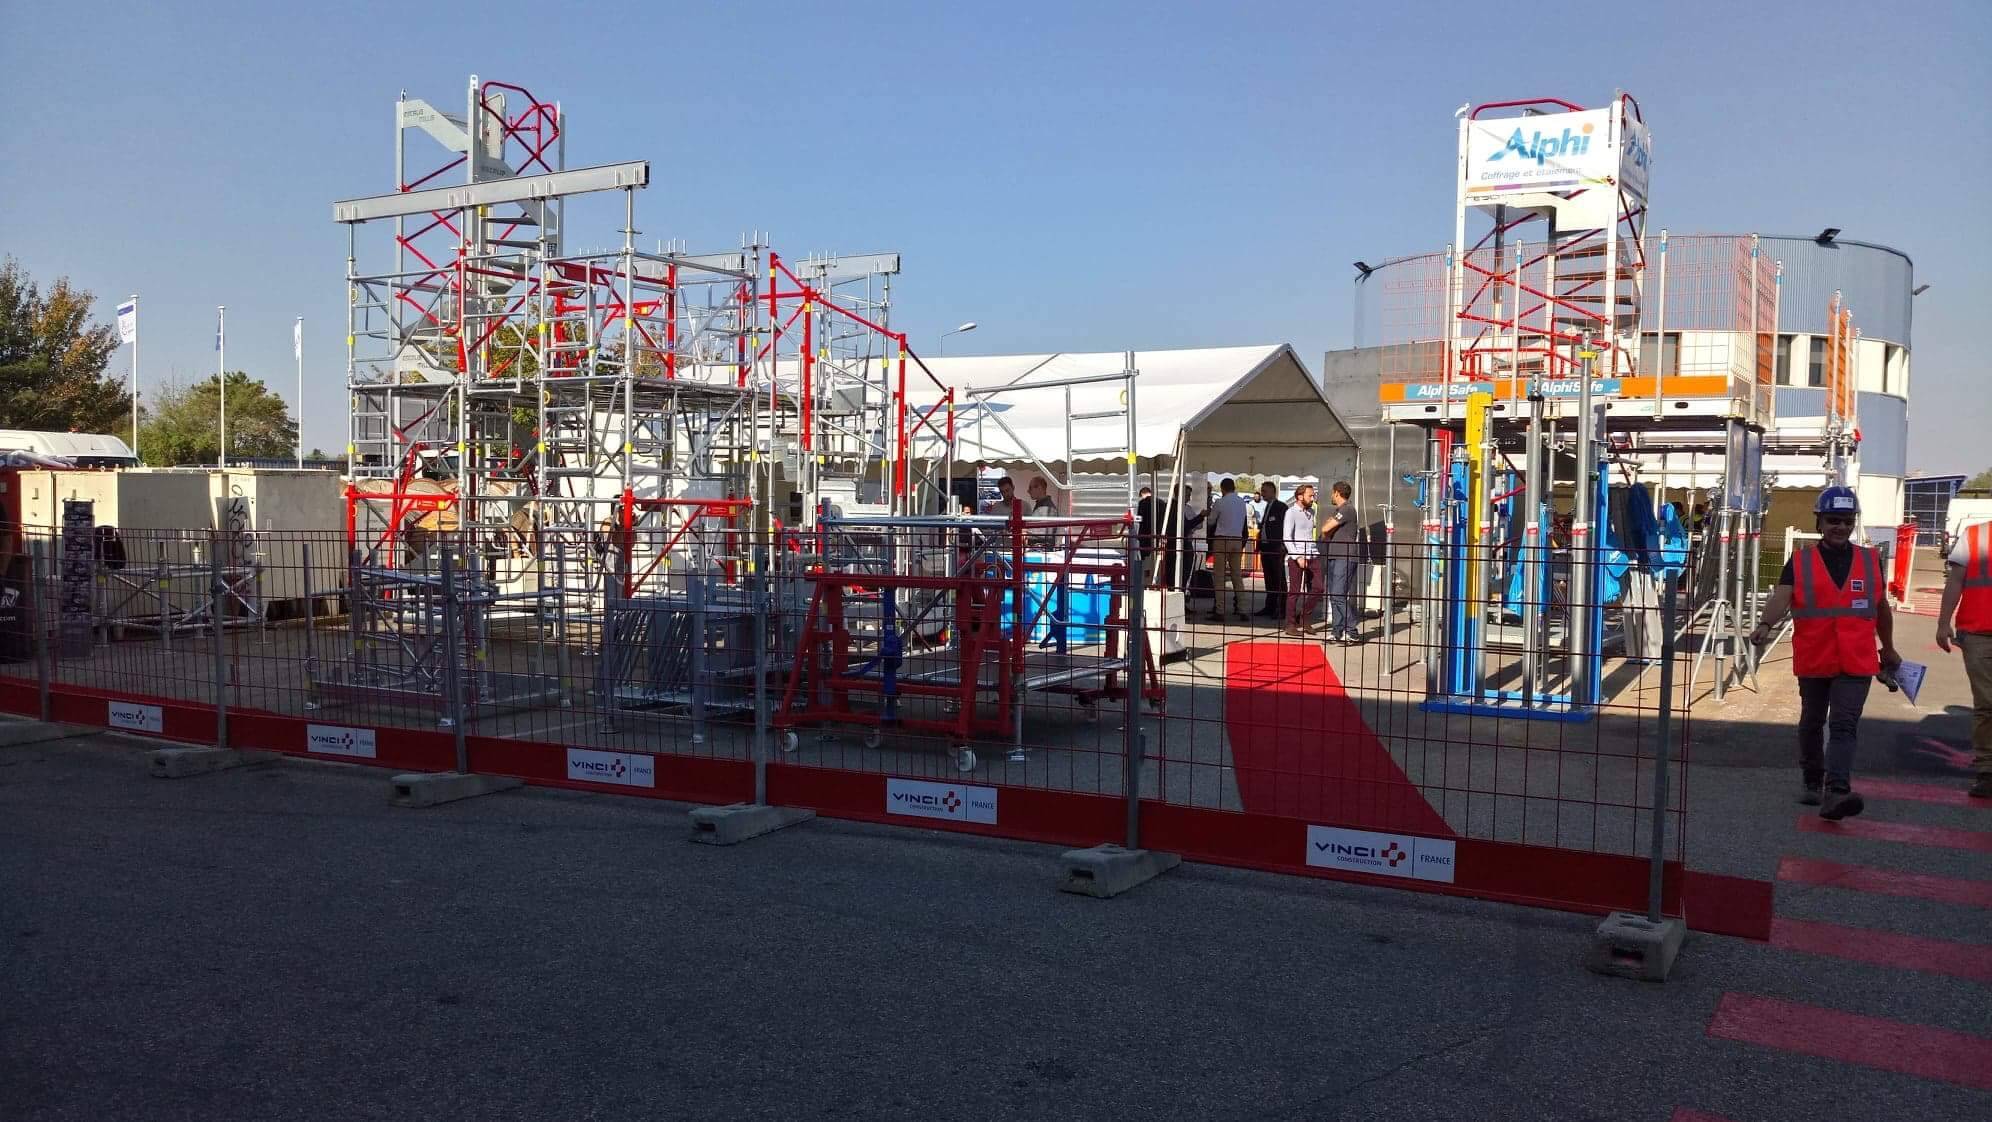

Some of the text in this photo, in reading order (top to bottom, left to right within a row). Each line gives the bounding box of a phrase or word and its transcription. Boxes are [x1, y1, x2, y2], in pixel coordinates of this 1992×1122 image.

[1487, 122, 1595, 166] Alphi
[1481, 168, 1520, 181] Coffrage
[1522, 170, 1533, 178] et
[1541, 381, 1604, 397] AlphiSfe
[112, 711, 135, 720] VINCI
[312, 735, 340, 745] VINCI
[572, 760, 608, 772] VINCI
[893, 792, 938, 806] VINCI
[971, 799, 994, 810] FRANCE
[1315, 841, 1376, 858] VINCI
[1337, 855, 1382, 867] CONSTRUCTION
[1420, 854, 1451, 866] FRANCE
